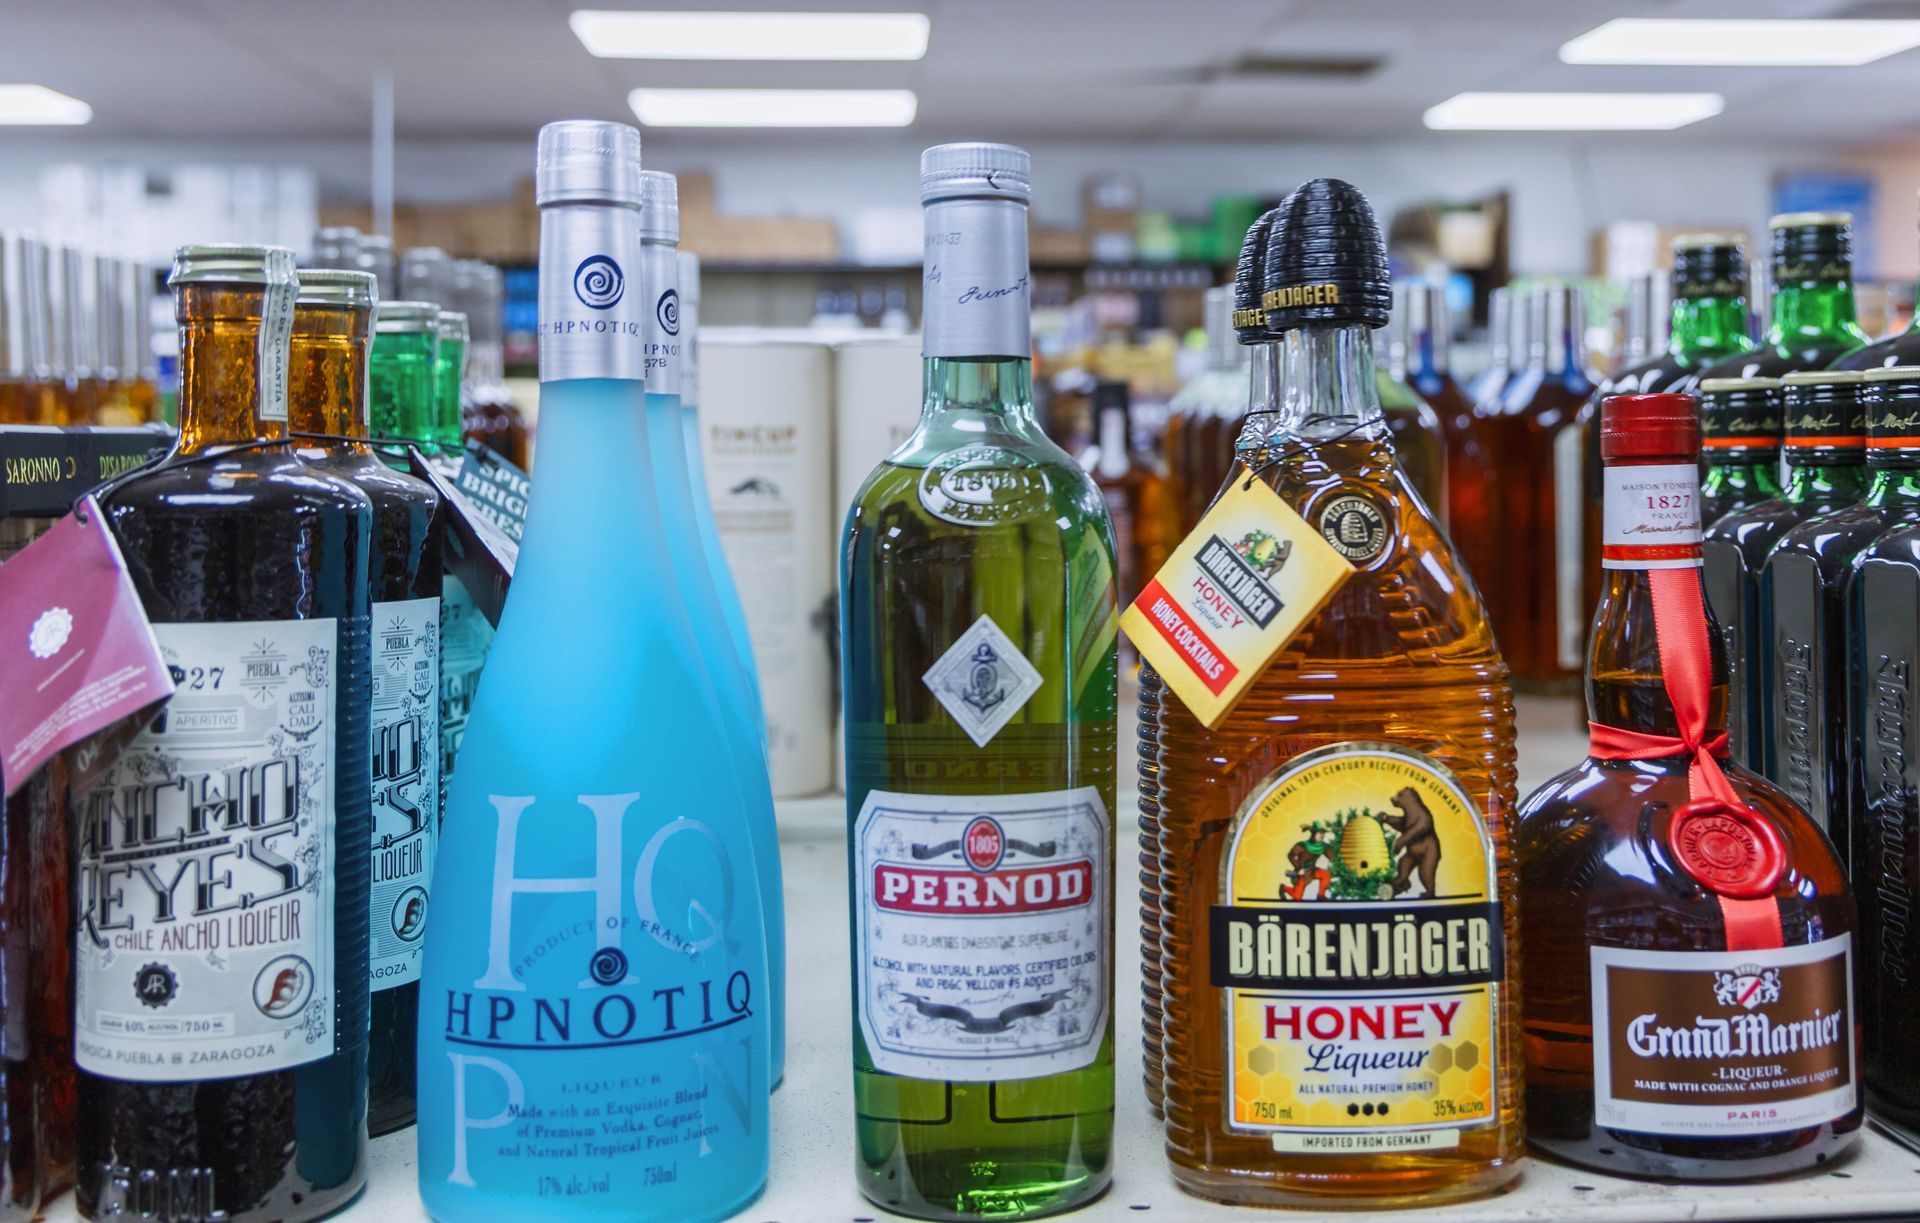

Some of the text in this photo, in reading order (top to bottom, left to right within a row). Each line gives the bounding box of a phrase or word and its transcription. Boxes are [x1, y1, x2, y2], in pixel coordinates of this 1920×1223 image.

[554, 319, 639, 337] HPNOTIQ
[5, 457, 60, 485] SARONNO
[1647, 494, 1690, 509] 1827
[1200, 542, 1276, 622] BÄRENJÄGER
[1192, 576, 1244, 629] HONEY
[386, 637, 410, 651] PUEBLA
[1151, 597, 1226, 681] HONEY COCKTAILS
[246, 663, 281, 678] PUEBLA
[175, 714, 238, 727] APERITIVO
[289, 716, 316, 728] DAD
[1261, 783, 1298, 818] ORIGINAL
[1322, 760, 1365, 776] CENTURY
[1369, 760, 1401, 774] RECIPE
[1404, 767, 1429, 785] FROM
[1428, 781, 1461, 815] GERMANY
[969, 835, 999, 854] 1805
[373, 838, 423, 884] LIQUEUR
[881, 868, 1084, 908] PERNOD
[115, 898, 301, 951] CHILE ANCHO LIQUEUR
[514, 916, 701, 978] PRODUCT OF FRANCE
[1228, 914, 1492, 979] BÄRENJÄGER
[873, 956, 905, 972] ALCOHOL
[907, 962, 928, 974] WITH
[930, 964, 973, 977] NATURAL
[1025, 957, 1069, 974] CERTIFIED
[1070, 950, 1097, 967] COLORS
[916, 976, 935, 989] AND
[966, 978, 1005, 991] YELLOW
[1023, 973, 1055, 988] ADDED
[445, 969, 753, 1042] HPNOTIQ
[1264, 1001, 1462, 1041] HONEY
[1627, 1008, 1841, 1059] Grand Marnier
[116, 1050, 166, 1065] PUEBLA
[188, 1043, 276, 1065] ZARAGOZA
[1304, 1043, 1430, 1078] Liqueur
[561, 1074, 662, 1094] LIQUEUR
[1299, 1080, 1434, 1095] ALL NATURAL PREMIUM HONEY
[1635, 1067, 1839, 1092] MADE WITH COGNAC AND ORANGE LIQUEUR
[508, 1083, 709, 1118] Made with an Exquisite Blend
[1254, 1102, 1276, 1119] 750
[1279, 1106, 1293, 1120] ml
[1433, 1099, 1457, 1118] 35%
[1727, 1109, 1778, 1120] PARIS
[498, 1124, 720, 1158] and Natural Tropical Fruit Juices
[516, 1122, 530, 1138] of
[535, 1123, 596, 1138] Premium
[1302, 1133, 1431, 1149] IMPORTED FROM GERMANY
[538, 1175, 563, 1196] 17%
[643, 1160, 678, 1187] 750ml
